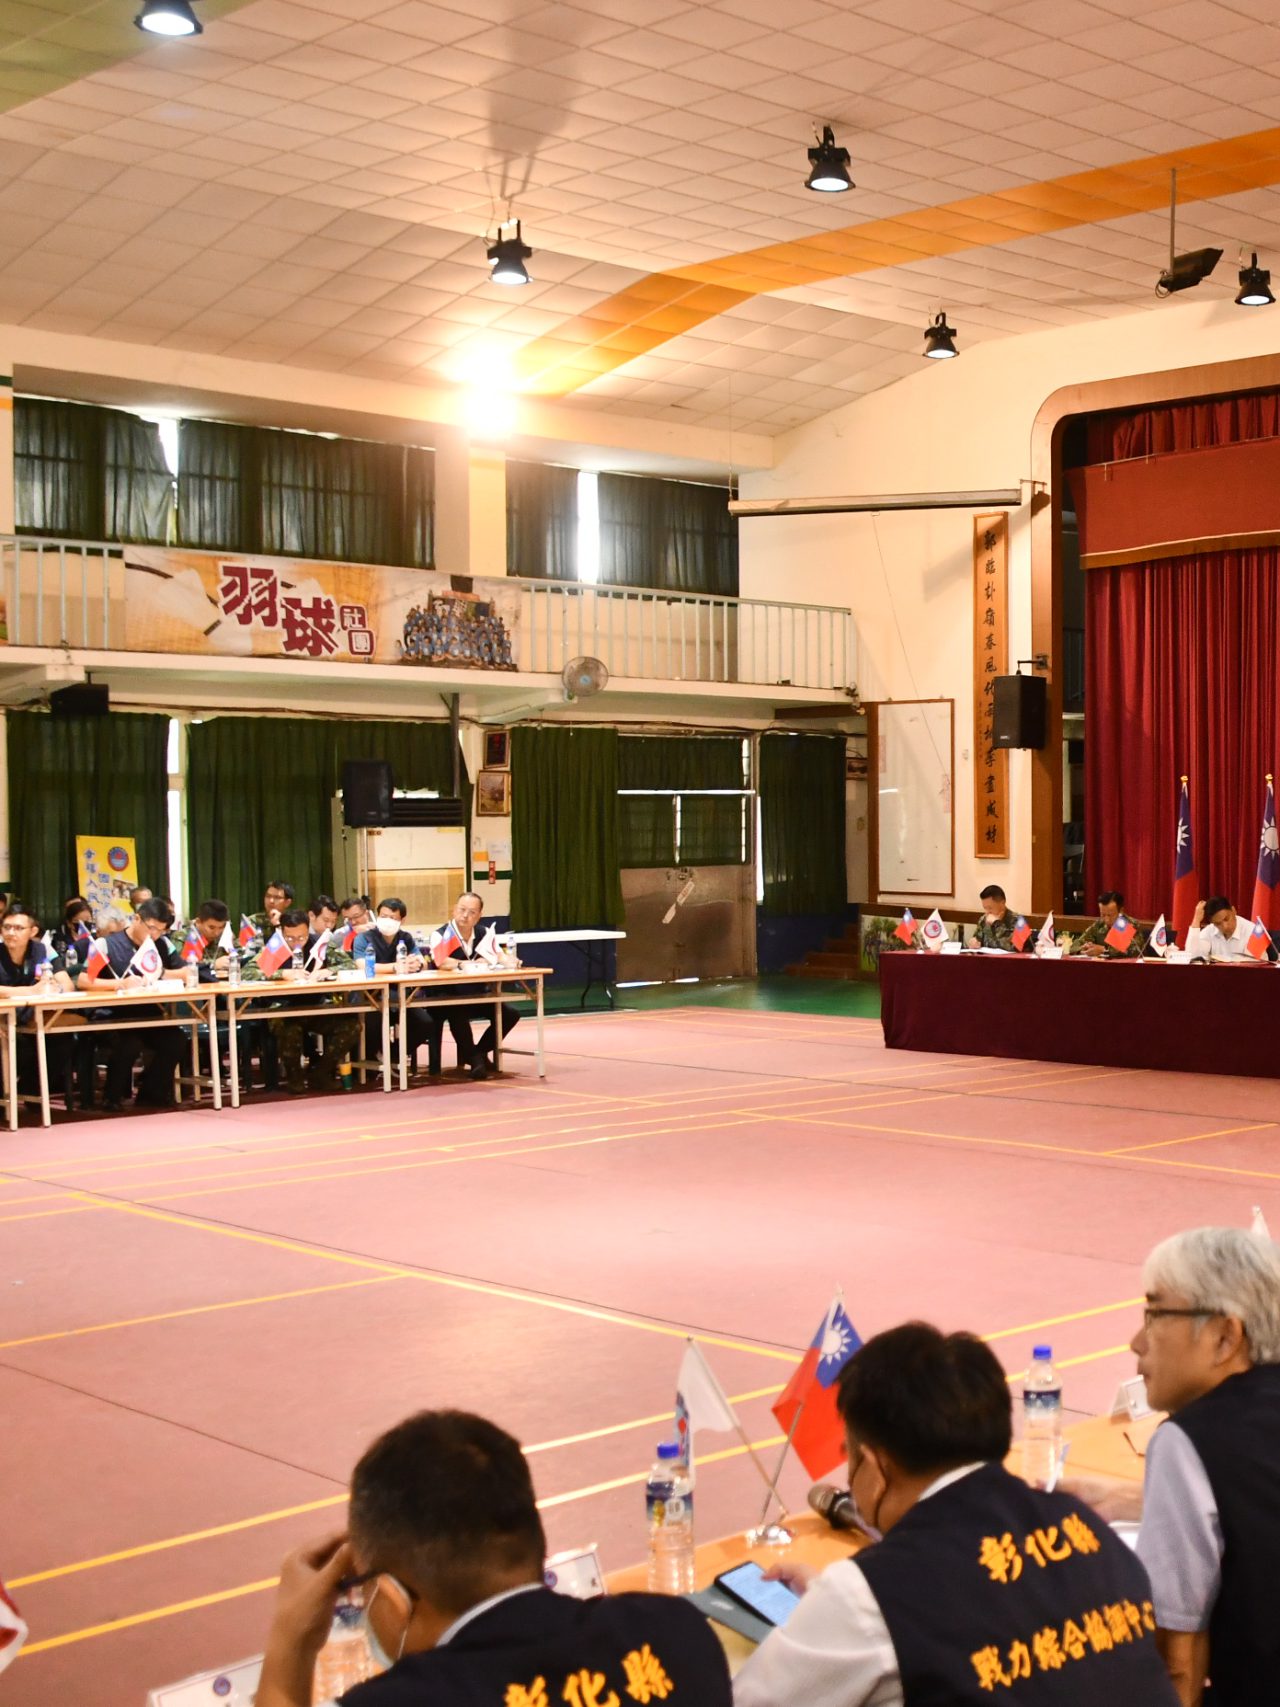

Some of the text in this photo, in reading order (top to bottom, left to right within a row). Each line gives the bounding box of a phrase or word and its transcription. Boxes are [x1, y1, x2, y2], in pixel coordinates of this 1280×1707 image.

[219, 564, 340, 657] 羽球
[978, 1512, 1102, 1585] 彰化縣
[970, 1598, 1156, 1692] 戰力綜合協調中心
